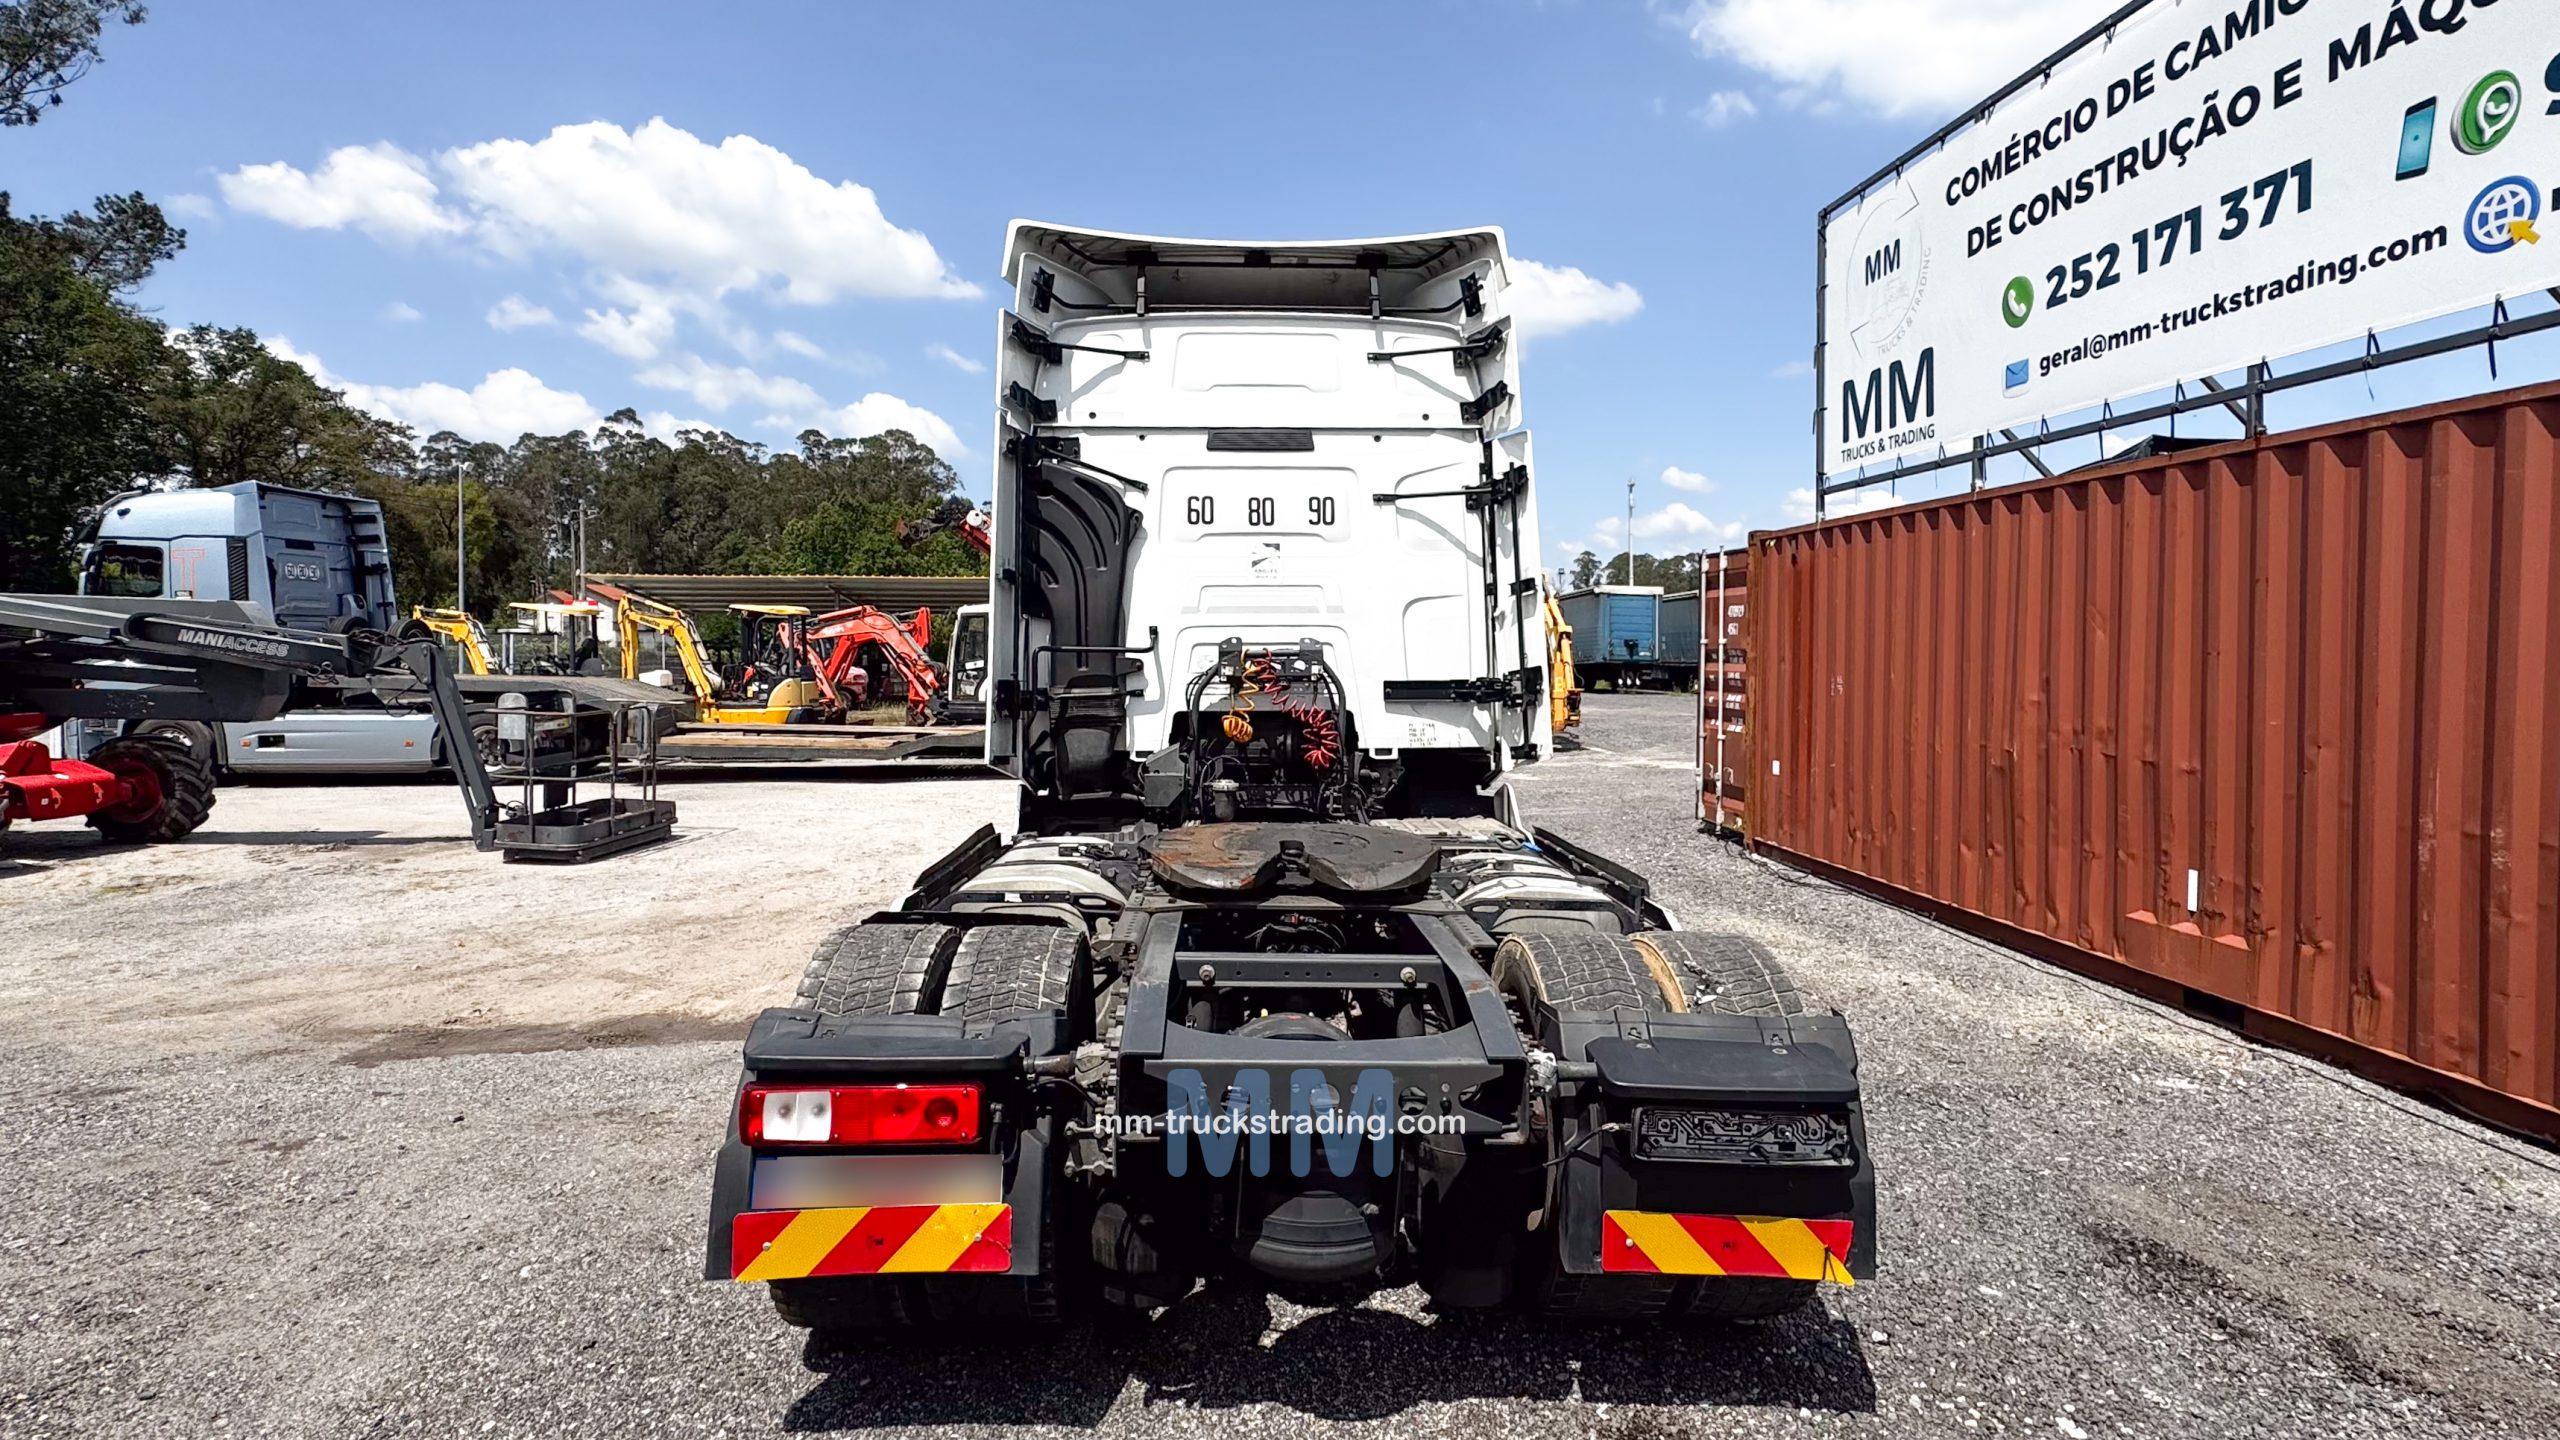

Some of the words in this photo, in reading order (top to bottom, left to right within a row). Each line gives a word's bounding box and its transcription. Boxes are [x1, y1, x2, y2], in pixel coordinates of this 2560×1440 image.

[1945, 98, 2098, 207] COMÉRCIO
[2106, 59, 2155, 119] DE
[1967, 214, 2002, 259] DE
[2008, 85, 2261, 235] CONSTRUÇÃO
[2273, 58, 2303, 110] E
[2328, 0, 2499, 84] MÁQ
[1865, 238, 1901, 287] MM
[2045, 242, 2121, 310] 252
[2132, 205, 2202, 275] 171
[2218, 158, 2313, 242] 371
[2039, 225, 2448, 377] geral@mm-truckstrading.com
[1841, 441, 1876, 463] TRUCKS
[1877, 438, 1886, 453] &
[1888, 423, 1935, 450] TRADING
[1842, 346, 1935, 444] MM
[1187, 495, 1214, 525] 60
[1248, 497, 1275, 527] 80
[1308, 496, 1335, 526] 90
[177, 628, 290, 658] MANIACCESS
